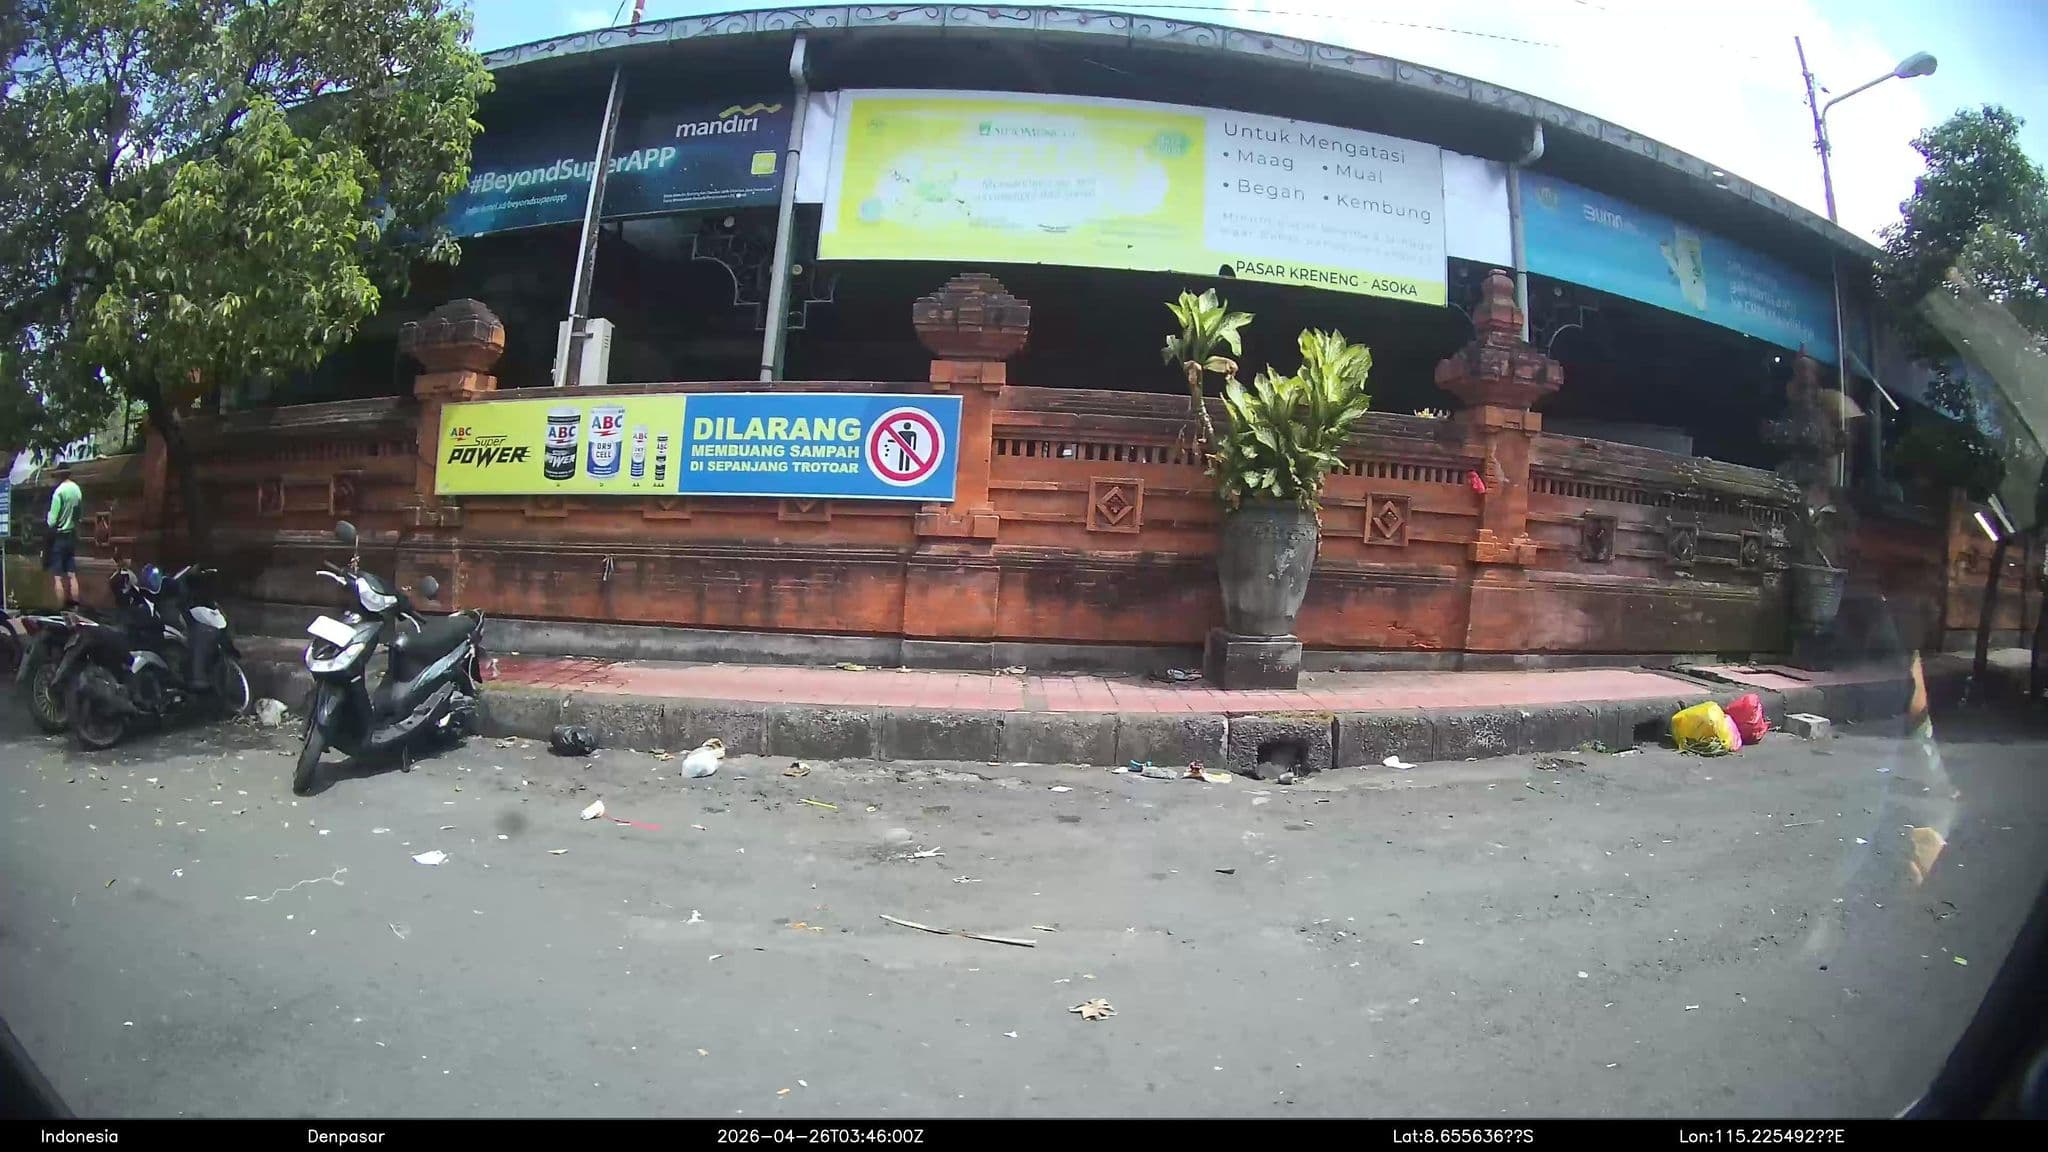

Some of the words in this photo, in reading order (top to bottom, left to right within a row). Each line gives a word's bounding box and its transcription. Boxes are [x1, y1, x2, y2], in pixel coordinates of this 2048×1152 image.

[676, 115, 759, 137] mandiri
[1224, 121, 1290, 143] Untuk
[1300, 132, 1405, 164] Mengatasi
[1238, 149, 1294, 171] Maag
[1336, 163, 1383, 183] Mual
[1238, 178, 1305, 201] Began
[1337, 194, 1431, 224] Kembung
[1236, 260, 1285, 278] PASAR
[1290, 267, 1359, 287] KRENENG
[1371, 279, 1417, 296] ASOKA
[450, 427, 472, 436] ABC
[548, 426, 577, 438] ABC
[592, 415, 623, 430] ABC
[692, 417, 861, 441] DILARANG
[475, 435, 508, 447] Super
[691, 444, 785, 458] MEMBUANG
[789, 445, 860, 459] SAMPAH
[447, 446, 531, 468] POWER
[690, 460, 704, 471] DI
[707, 461, 788, 473] SEPANJANG
[791, 461, 859, 474] TROTOAR
